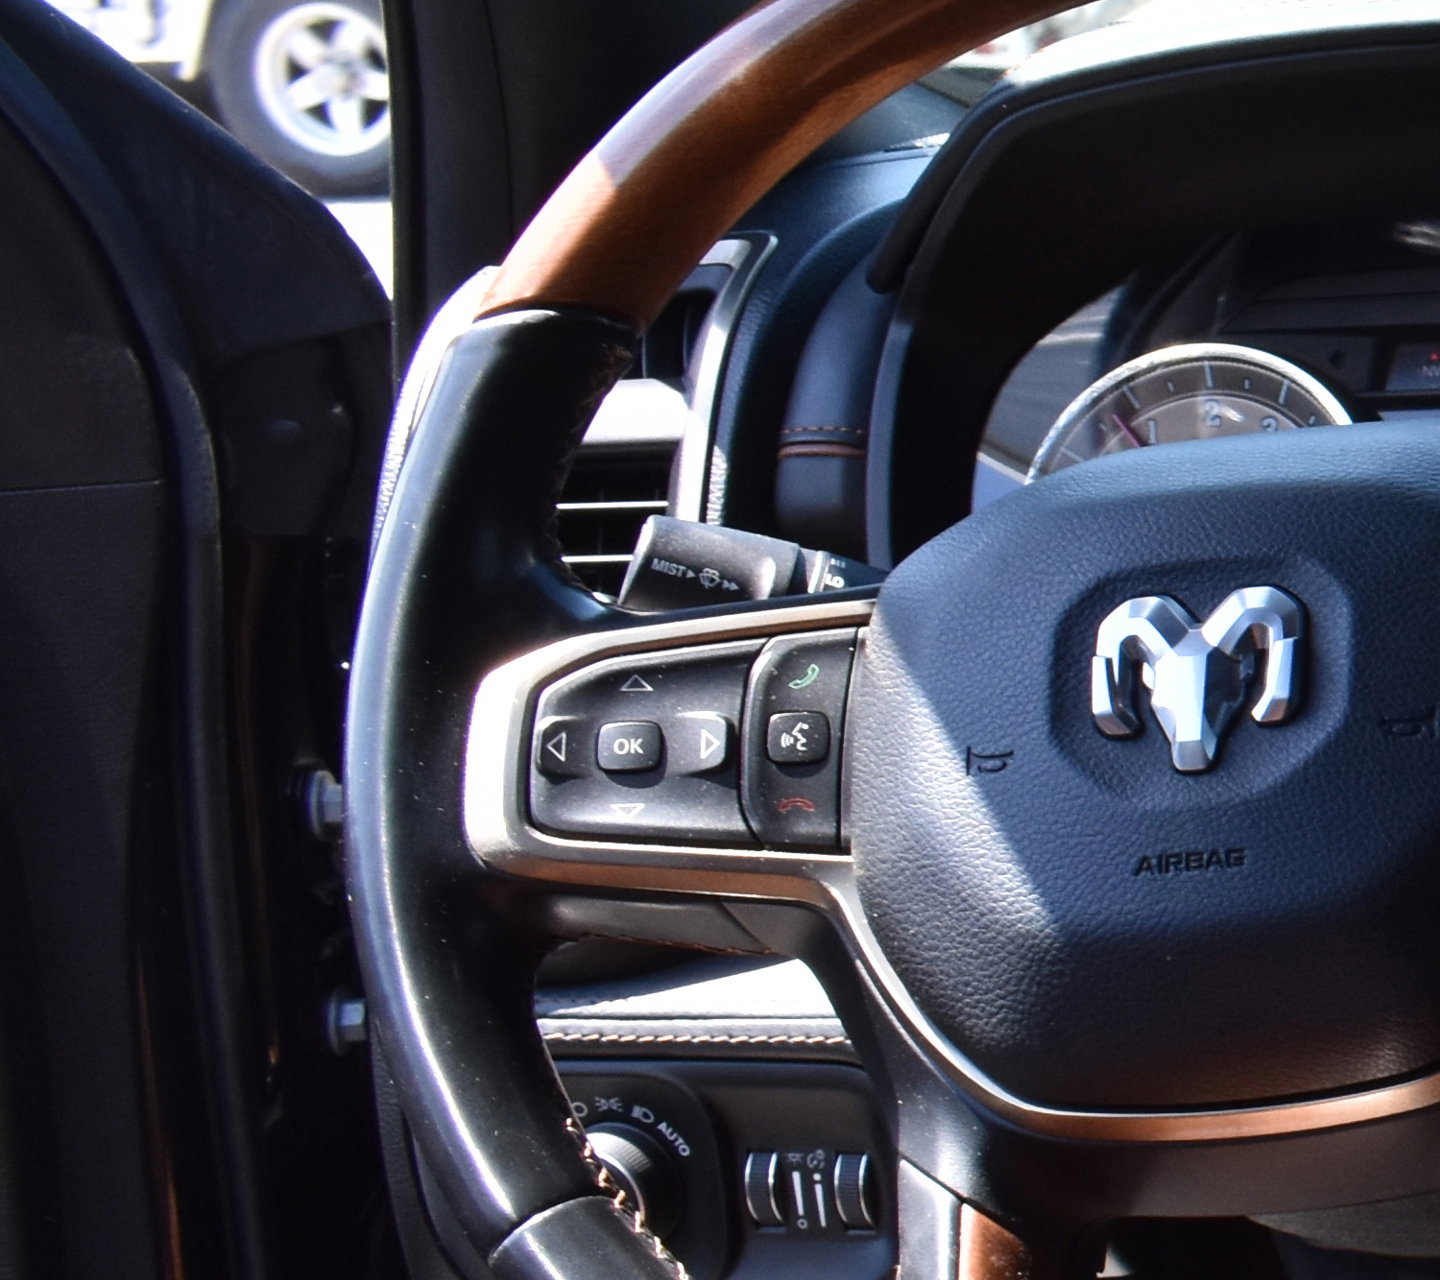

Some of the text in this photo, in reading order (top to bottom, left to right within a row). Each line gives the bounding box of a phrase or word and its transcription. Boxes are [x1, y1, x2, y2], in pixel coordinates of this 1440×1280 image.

[1203, 400, 1222, 428] 2
[651, 556, 687, 580] MIST
[613, 736, 644, 756] OK
[1134, 846, 1247, 878] AIRBAG
[656, 1119, 691, 1160] AUTO
